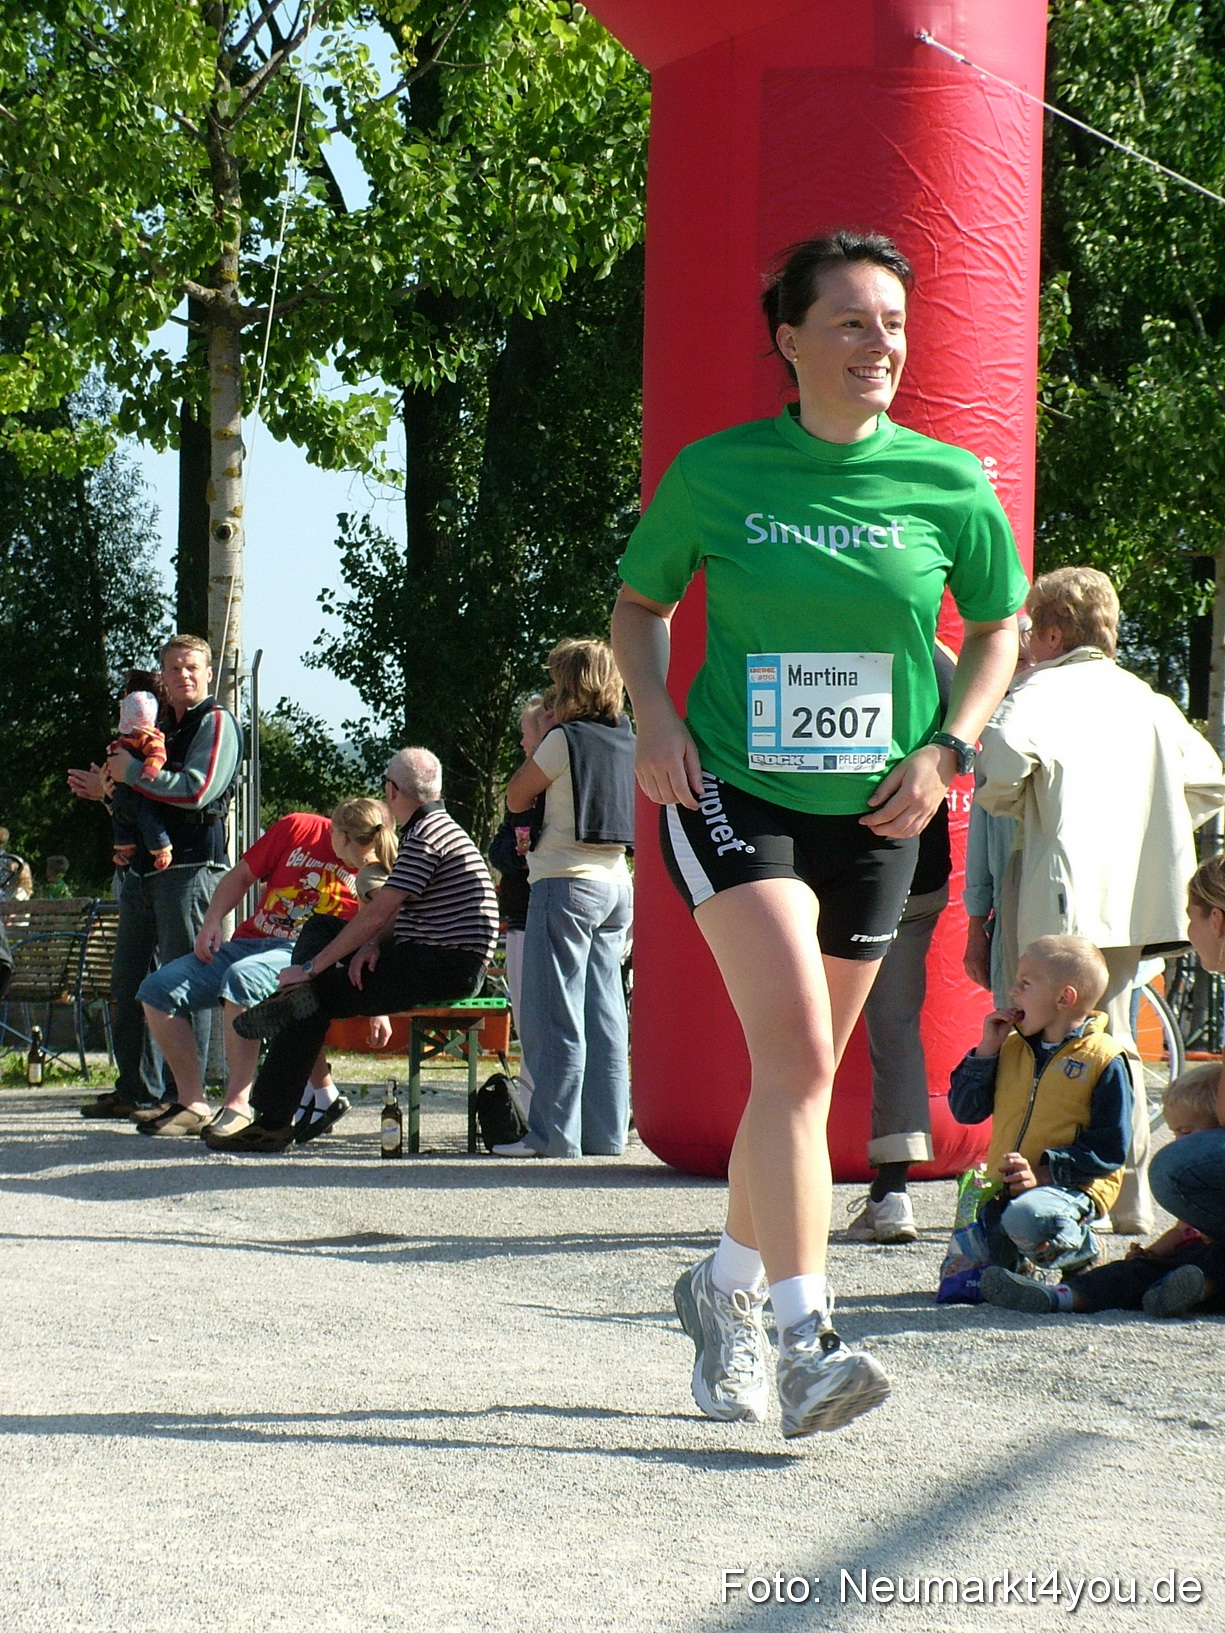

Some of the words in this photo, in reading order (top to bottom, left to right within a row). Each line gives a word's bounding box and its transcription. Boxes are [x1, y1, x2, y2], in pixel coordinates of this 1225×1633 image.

[744, 513, 907, 556] Sinupret
[788, 664, 858, 687] Martina
[754, 700, 763, 717] D
[791, 706, 881, 739] 2607
[285, 846, 311, 867] Bei
